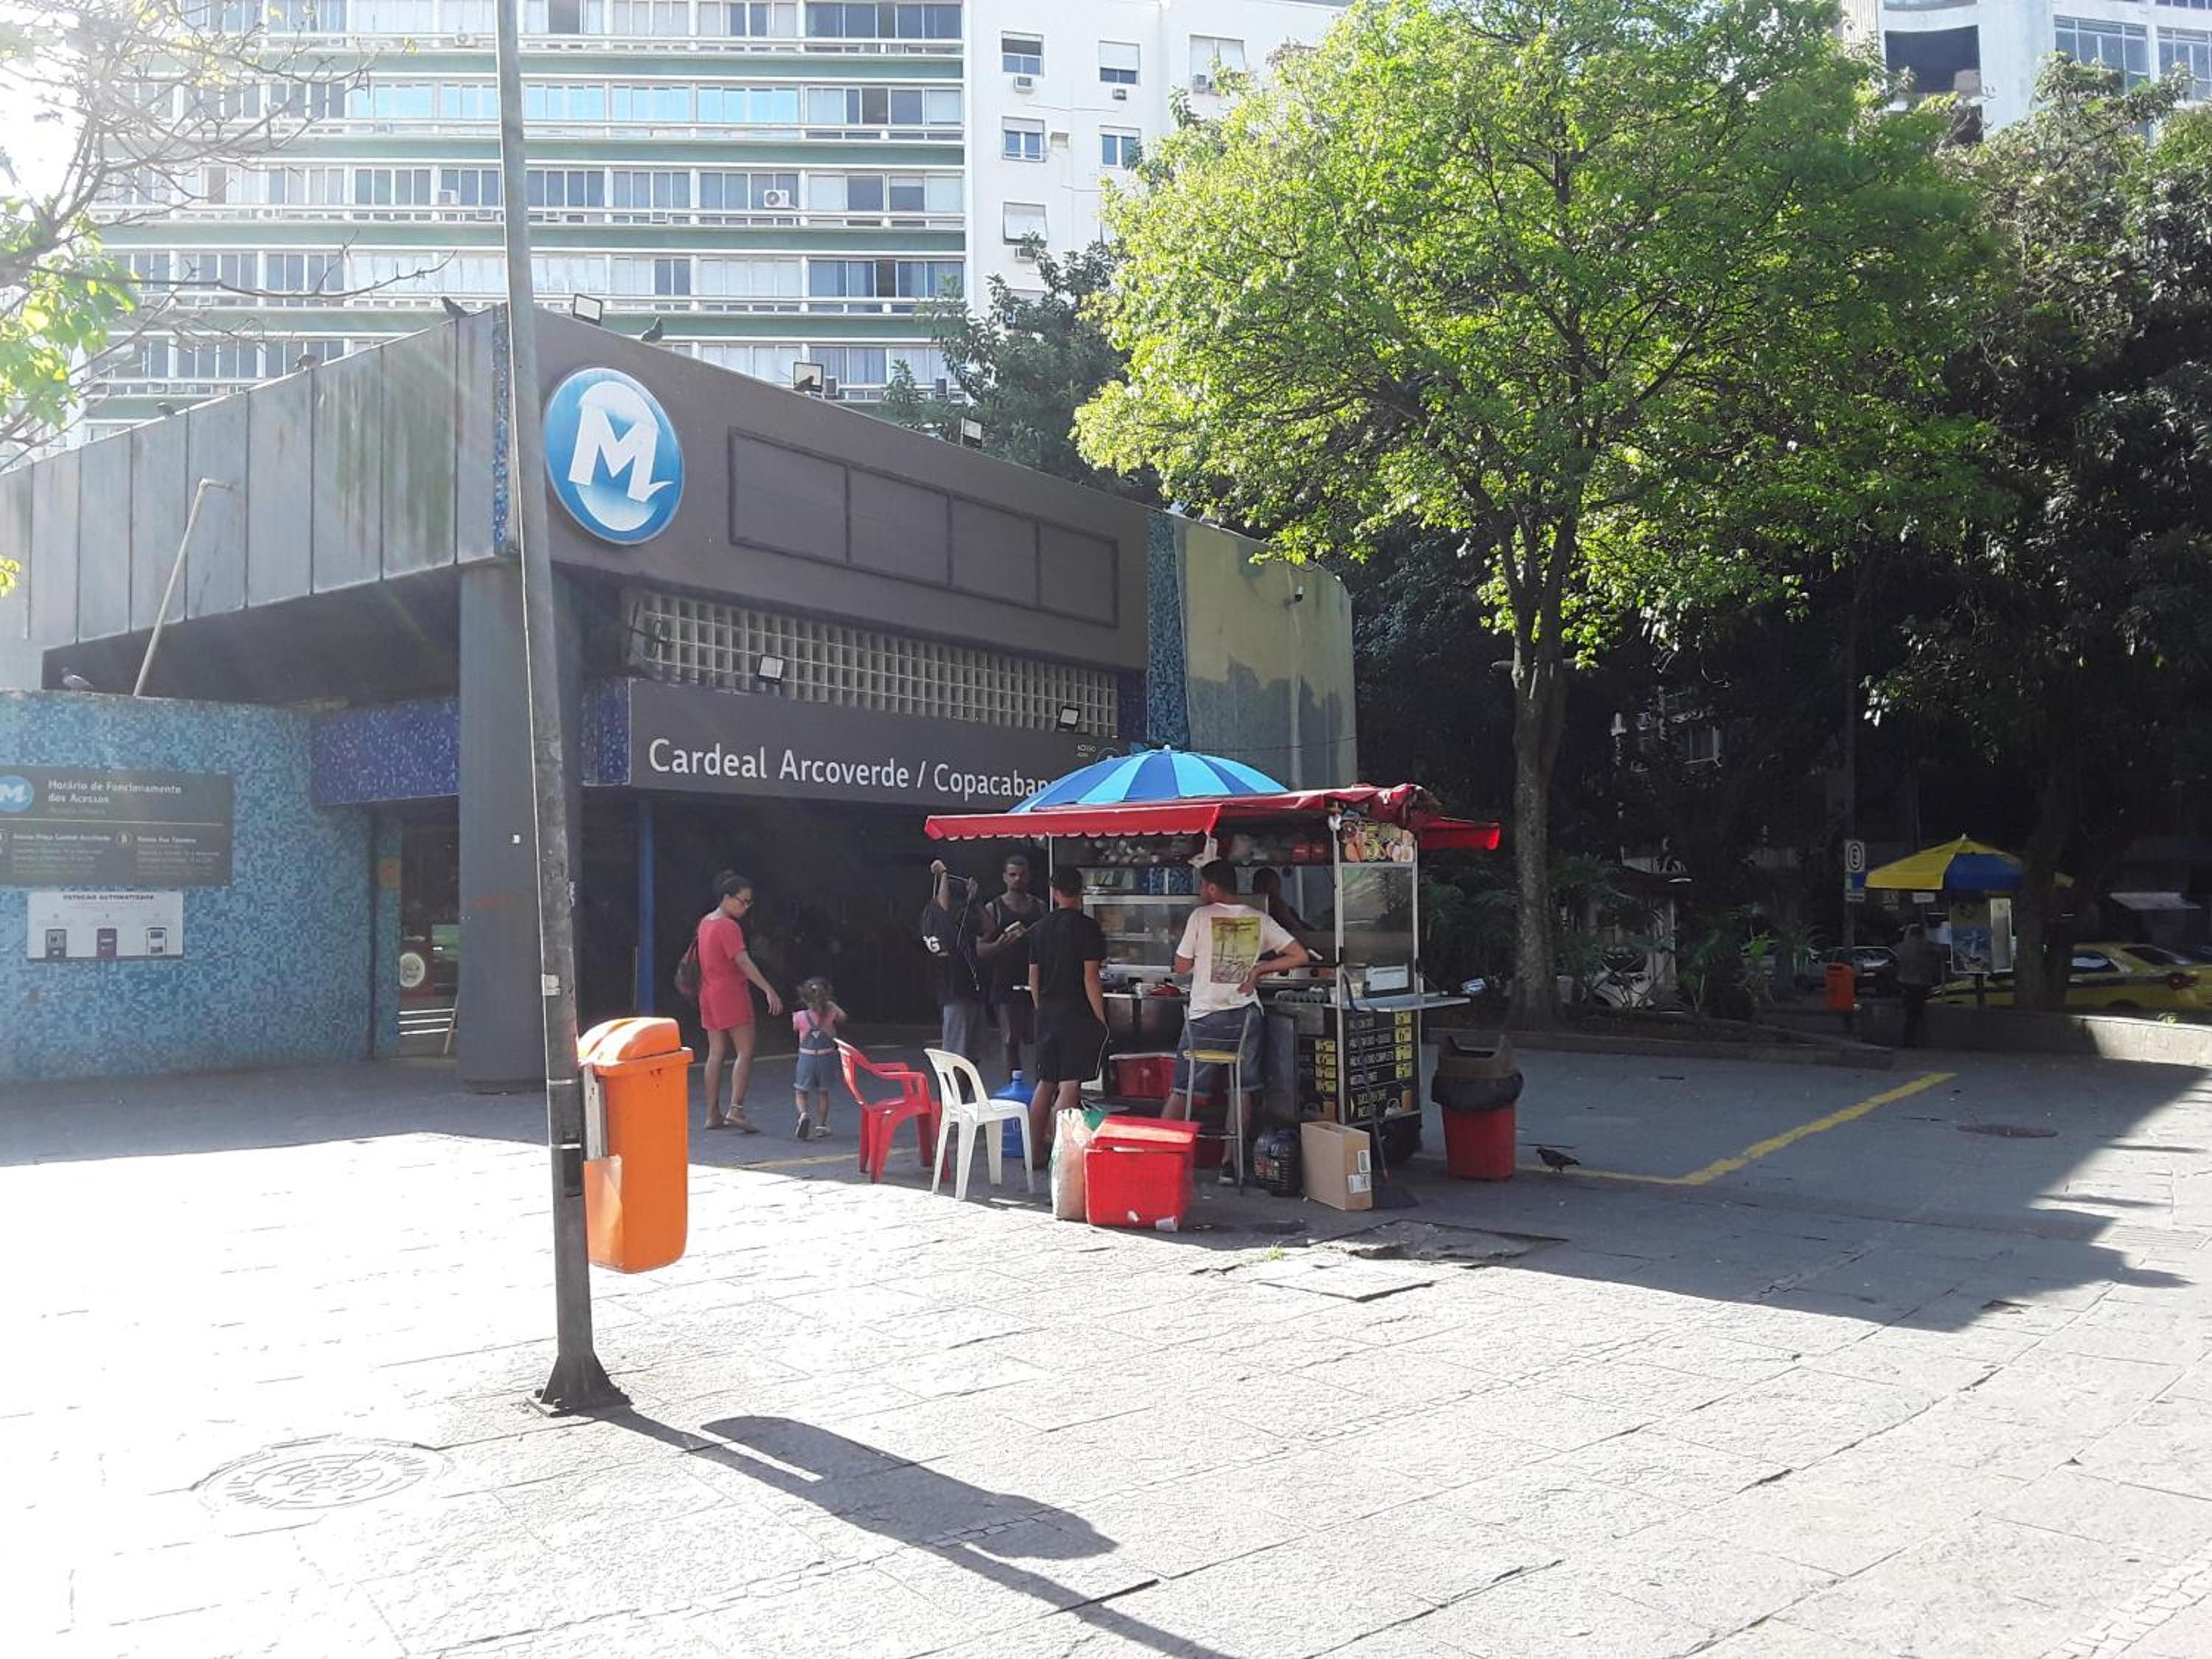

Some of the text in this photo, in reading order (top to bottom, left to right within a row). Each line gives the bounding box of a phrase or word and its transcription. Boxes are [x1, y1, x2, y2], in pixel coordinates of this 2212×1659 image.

[568, 403, 674, 504] M
[47, 779, 88, 790] Horário
[90, 781, 104, 792] de
[648, 737, 1057, 802] Cardeal Arcoverde / Copacaban
[47, 793, 66, 803] dos
